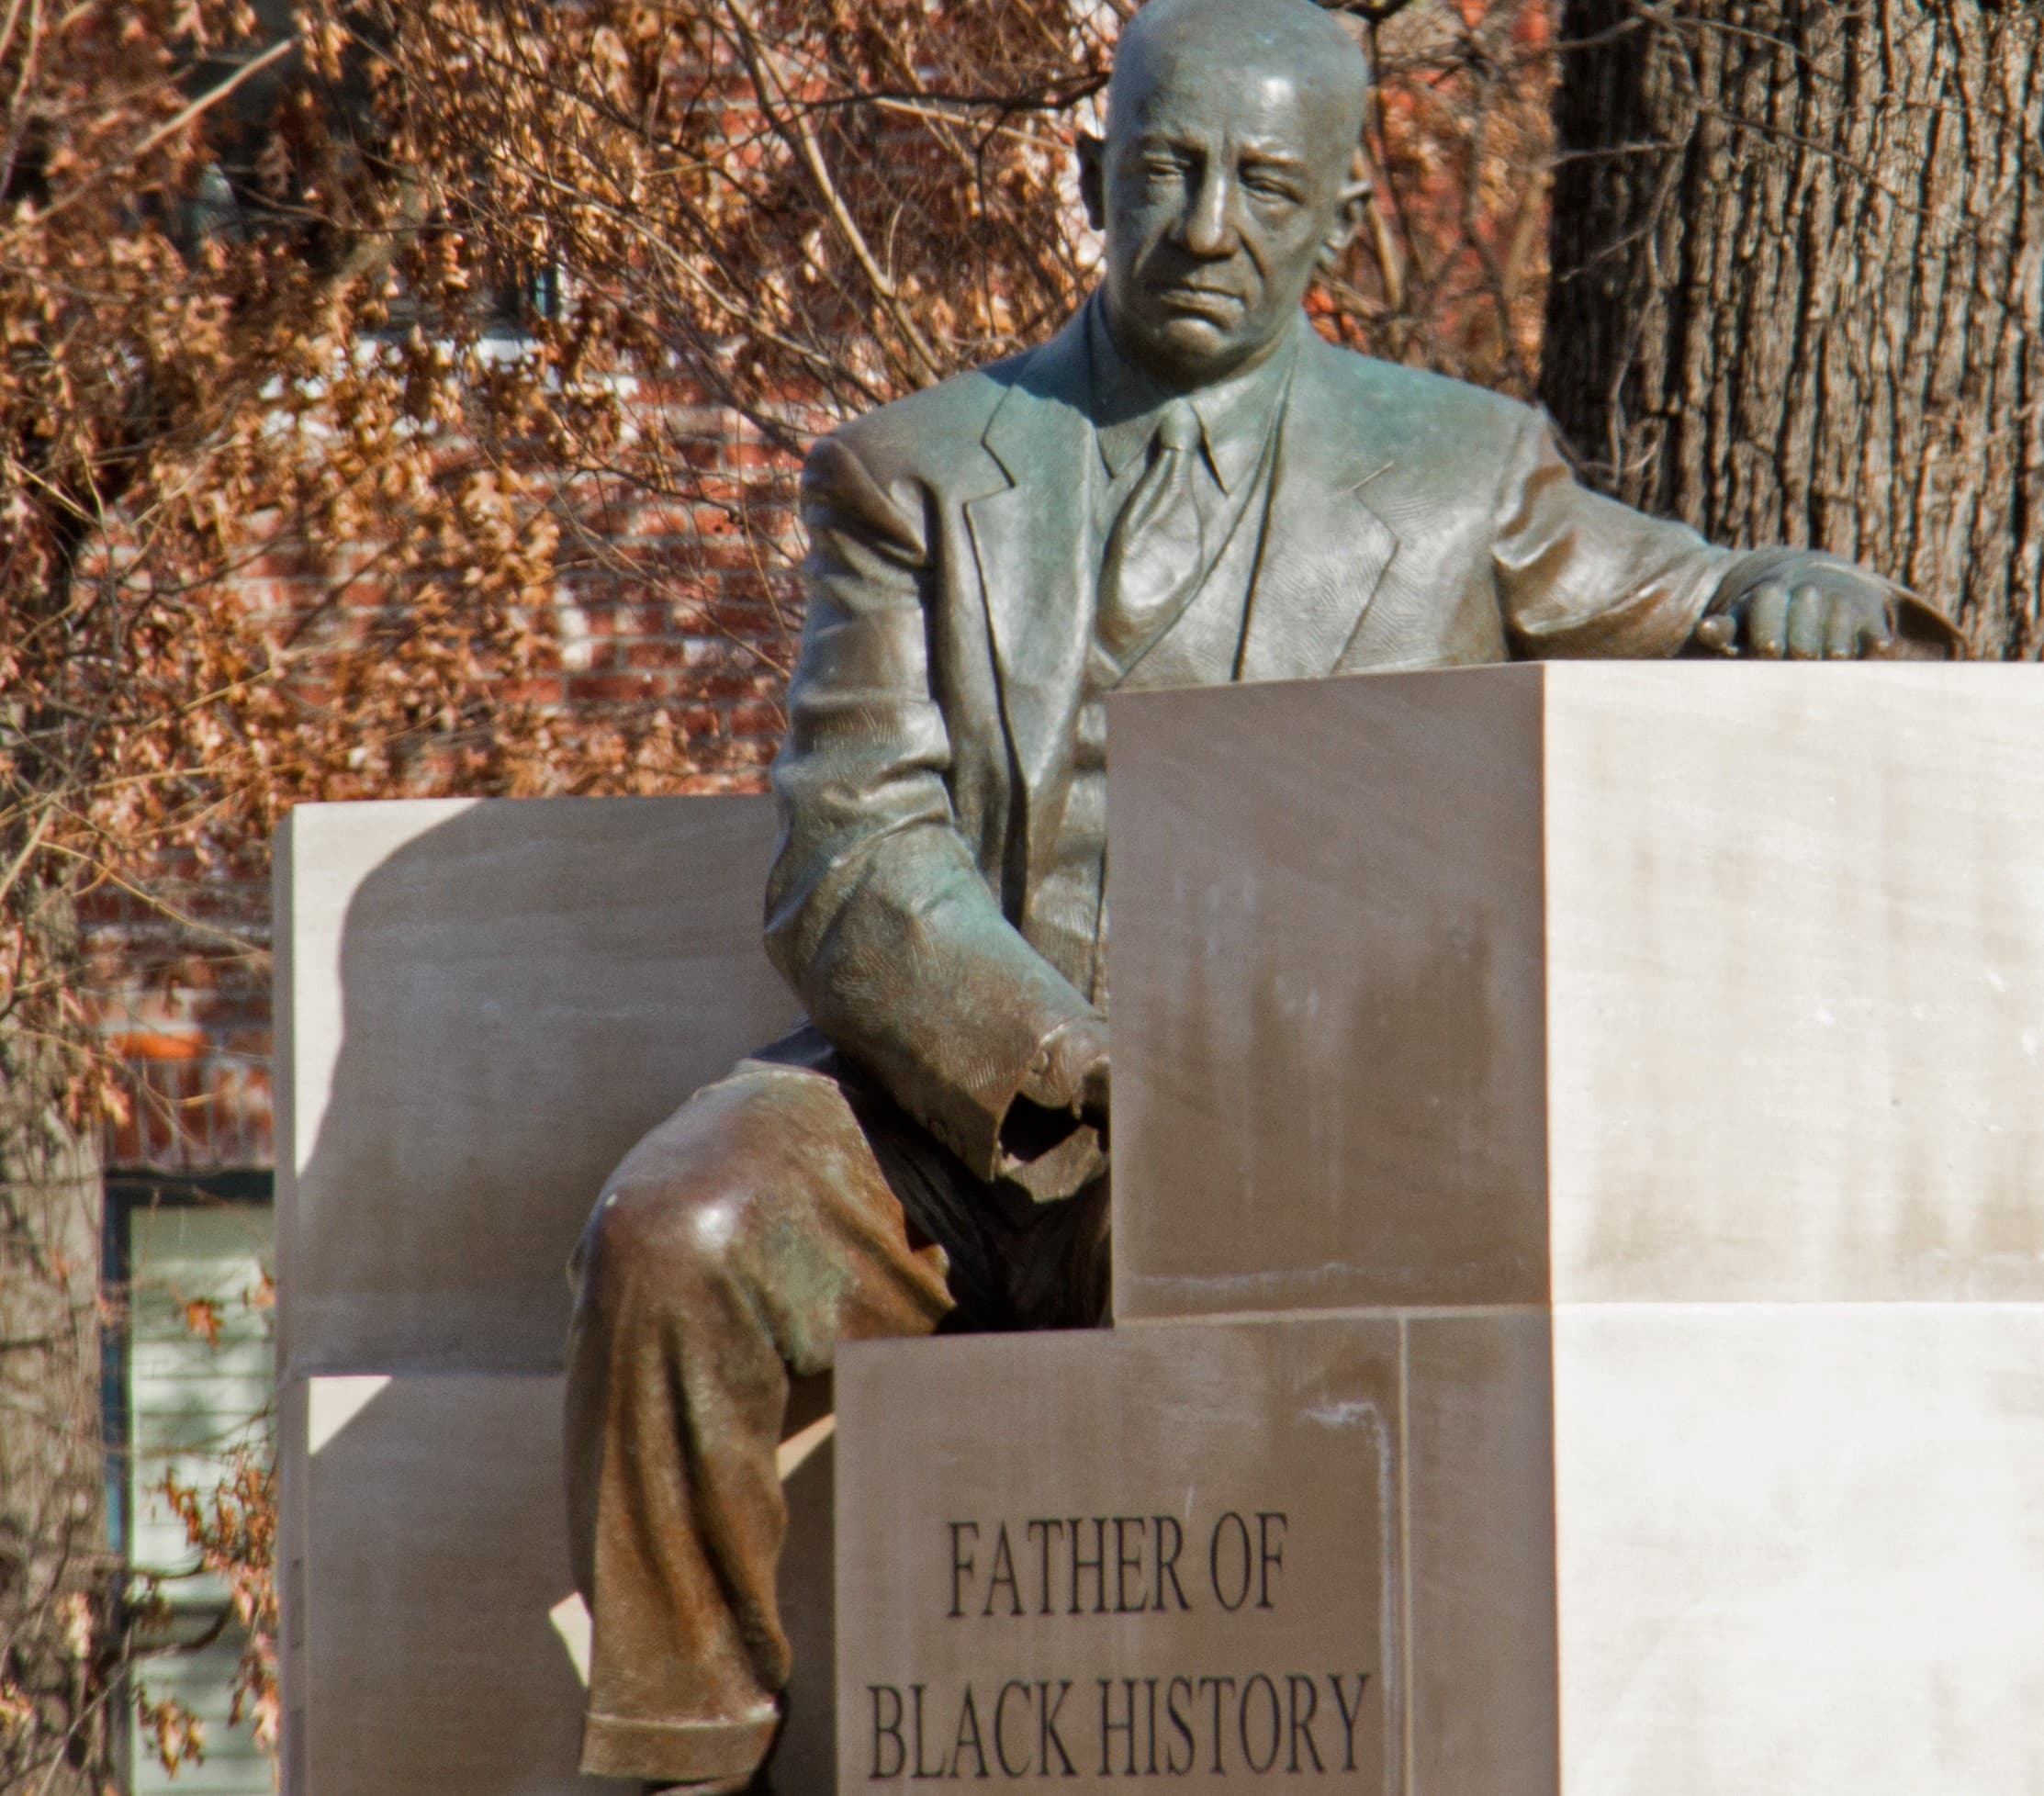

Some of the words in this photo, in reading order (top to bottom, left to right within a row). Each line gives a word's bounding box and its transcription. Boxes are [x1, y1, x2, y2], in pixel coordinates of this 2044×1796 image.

[946, 1515, 1191, 1619] FATHER
[1209, 1511, 1288, 1611] OF
[866, 1679, 1078, 1780] BLACK
[1096, 1673, 1371, 1777] HISTORY
